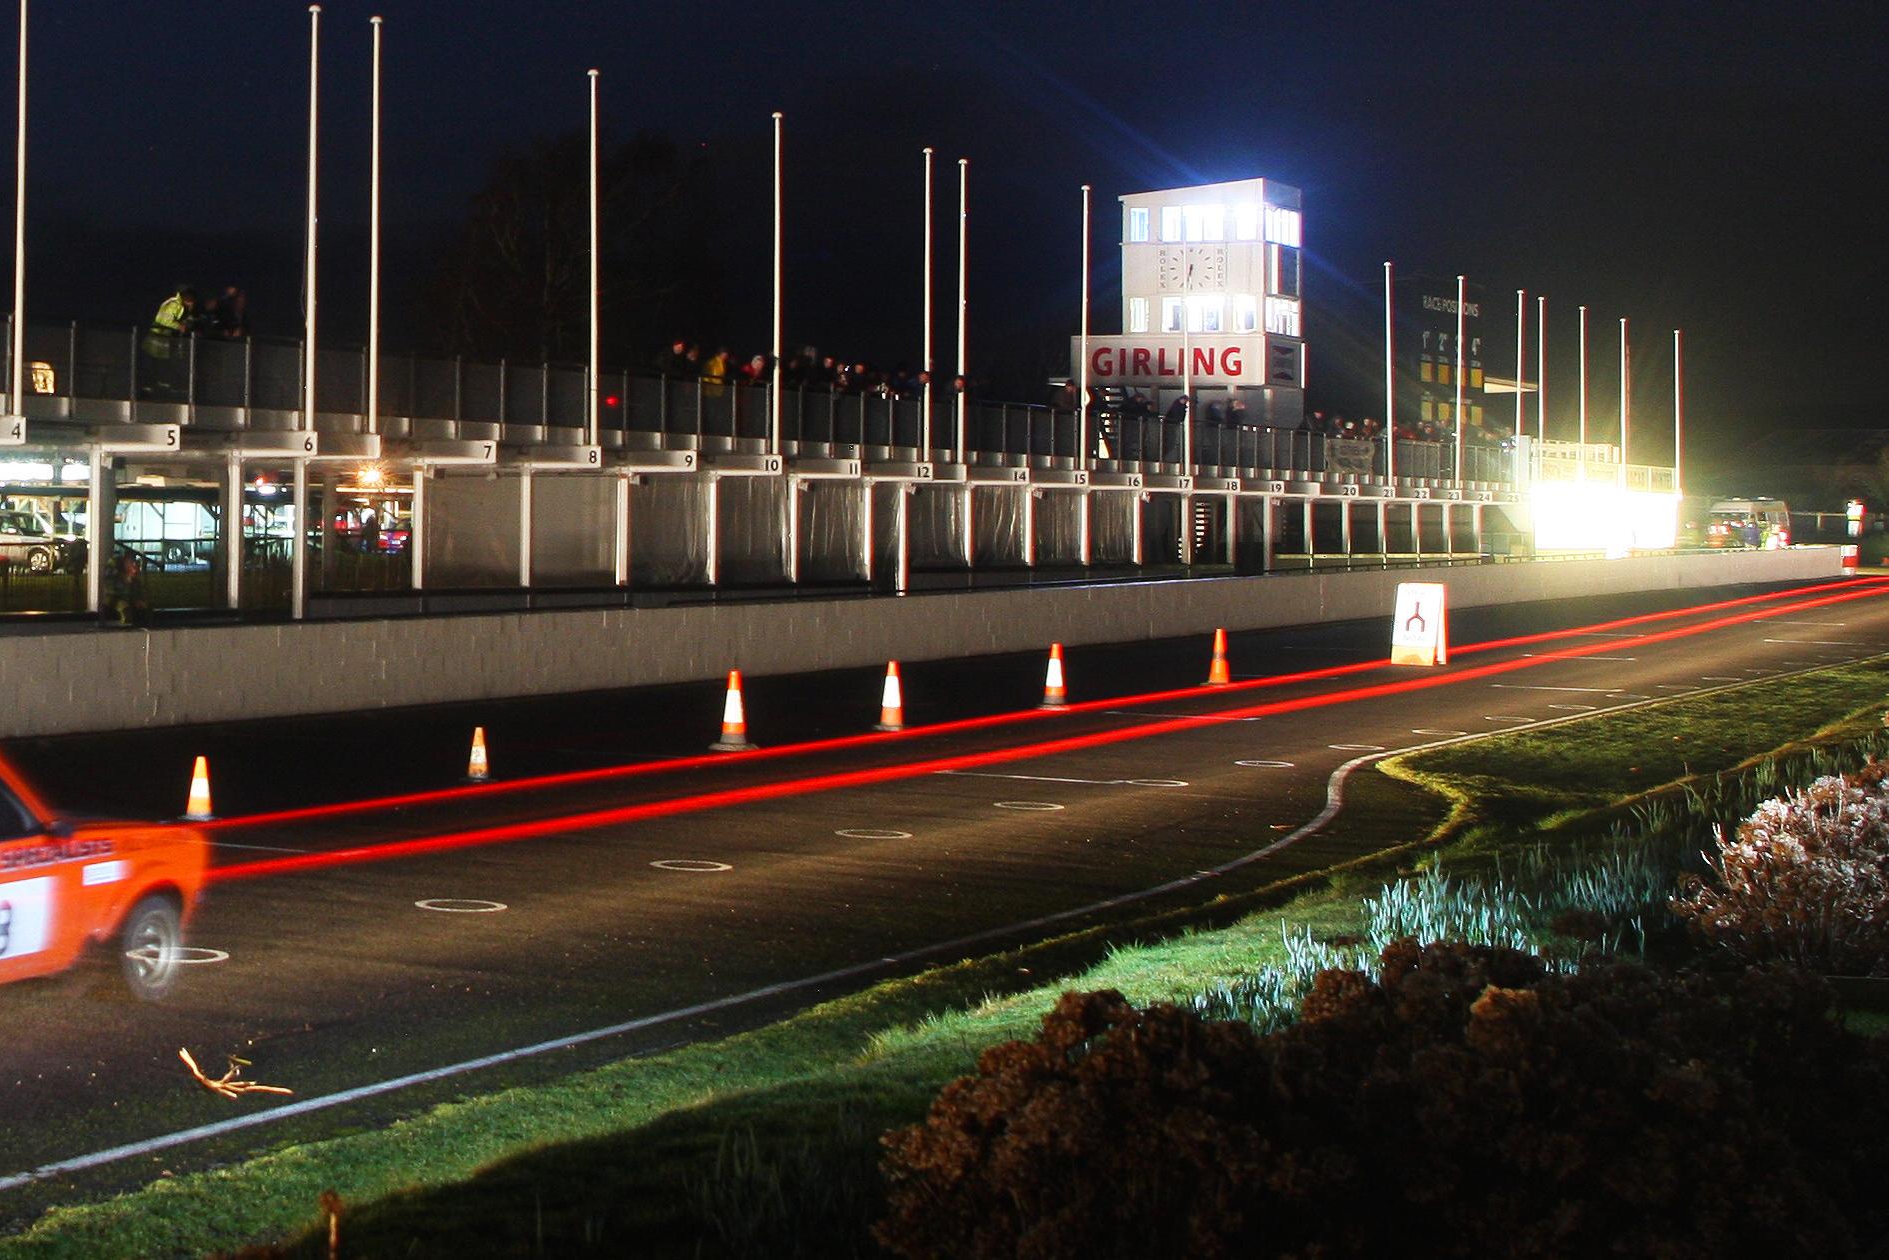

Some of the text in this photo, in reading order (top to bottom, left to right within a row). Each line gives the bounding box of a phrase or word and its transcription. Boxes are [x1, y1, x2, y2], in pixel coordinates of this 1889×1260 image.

[1216, 249, 1224, 287] ROLEX
[1442, 299, 1479, 317] POSIONS
[1091, 347, 1242, 377] GIRLING
[11, 423, 21, 439] 4
[167, 430, 175, 446] 5
[304, 437, 312, 451] 6
[484, 446, 492, 459] 7
[589, 451, 597, 464] 8
[685, 455, 693, 466] 9
[764, 460, 778, 471] 10
[850, 463, 858, 474] 11
[917, 467, 929, 478] 12
[1014, 471, 1026, 482] 14
[1074, 474, 1086, 484] 15
[1128, 477, 1140, 487] 16
[1179, 479, 1190, 489] 17
[1225, 481, 1238, 491] 18
[1270, 483, 1282, 492] 19
[1342, 487, 1356, 496] 20
[1383, 489, 1394, 497] 21
[1415, 490, 1427, 499] 22
[1448, 492, 1460, 501] 23
[1478, 494, 1490, 502] 24
